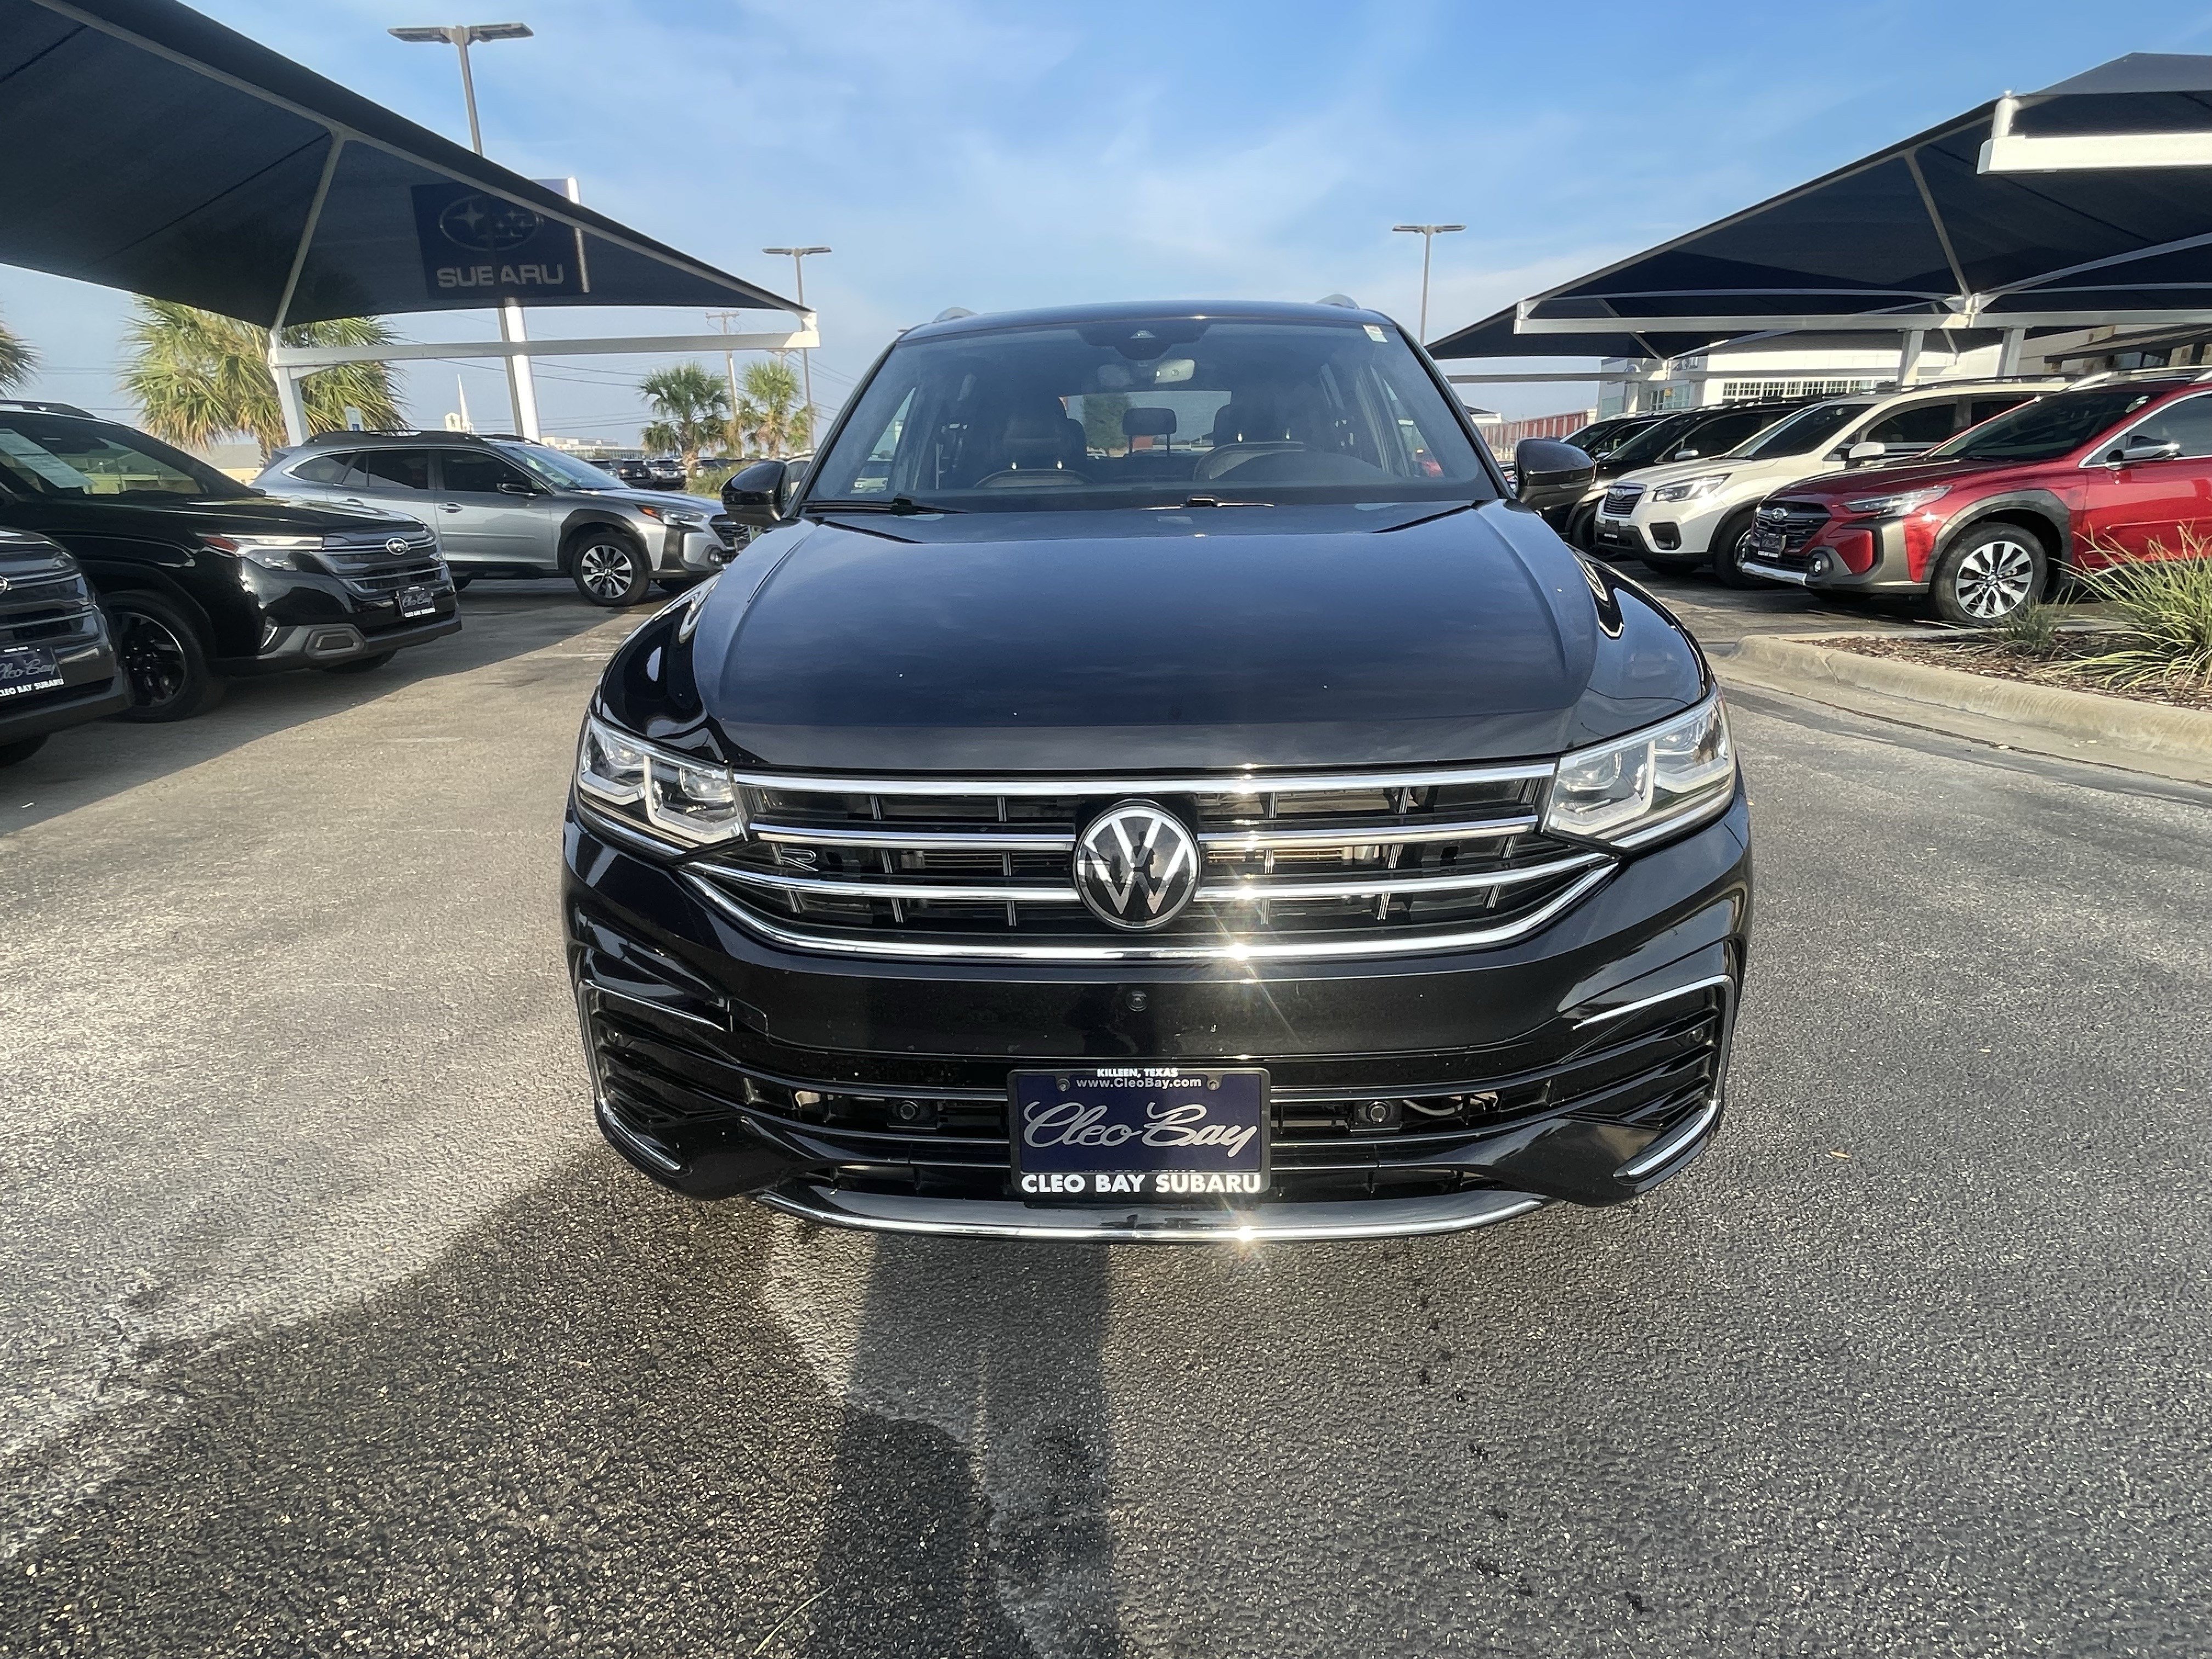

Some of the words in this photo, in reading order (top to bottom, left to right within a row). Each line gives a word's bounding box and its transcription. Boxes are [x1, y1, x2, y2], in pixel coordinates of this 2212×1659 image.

[437, 263, 565, 288] SUBARU
[1076, 1077, 1201, 1089] www.CleoBay.com
[1097, 1068, 1141, 1078] KILLEEN,
[1144, 1068, 1178, 1077] TEXAS
[1023, 1101, 1143, 1148] Cleo
[1141, 1102, 1257, 1158] Bay
[1022, 1174, 1086, 1193] CLEO
[1096, 1174, 1146, 1193] BAY
[1155, 1173, 1261, 1193] SUBARU
